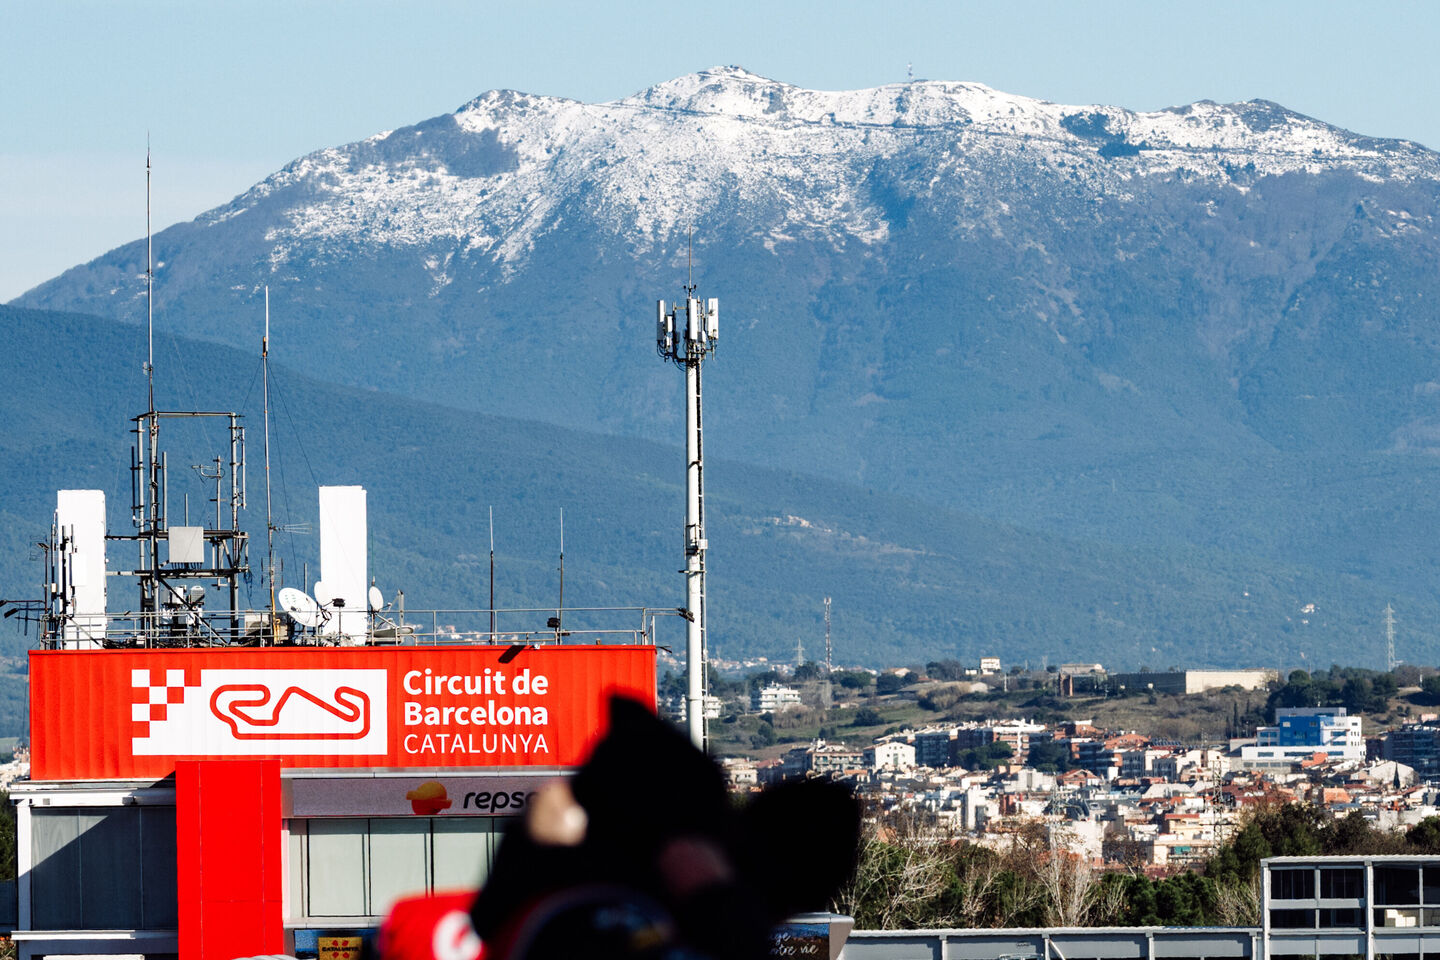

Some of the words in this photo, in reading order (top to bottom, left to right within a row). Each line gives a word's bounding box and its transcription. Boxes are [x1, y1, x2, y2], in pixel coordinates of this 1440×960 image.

[403, 668, 506, 695] Circuit
[512, 668, 549, 695] de
[404, 699, 548, 726] Barcelona
[404, 733, 549, 754] CATALUNYA
